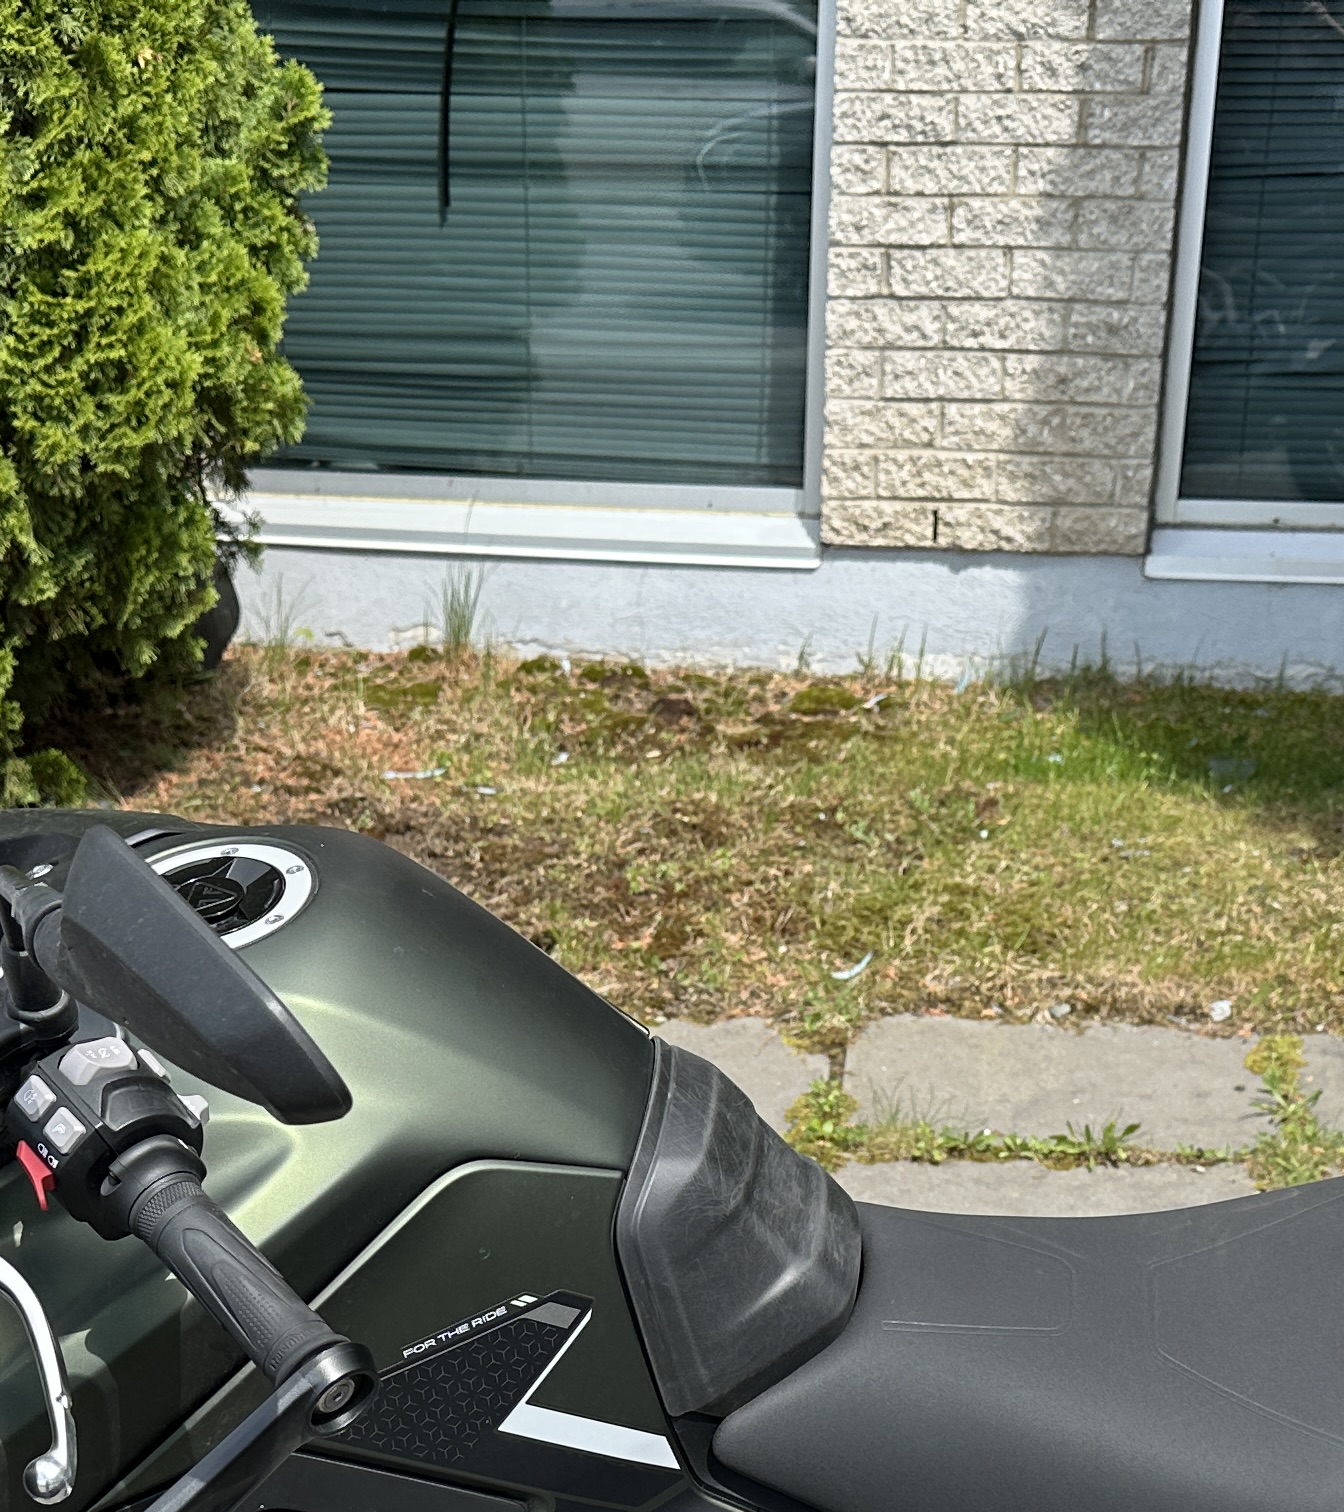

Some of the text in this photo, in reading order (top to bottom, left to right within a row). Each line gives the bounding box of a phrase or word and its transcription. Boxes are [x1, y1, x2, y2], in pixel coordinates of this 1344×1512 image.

[402, 1305, 508, 1359] FOR THE RIDE
